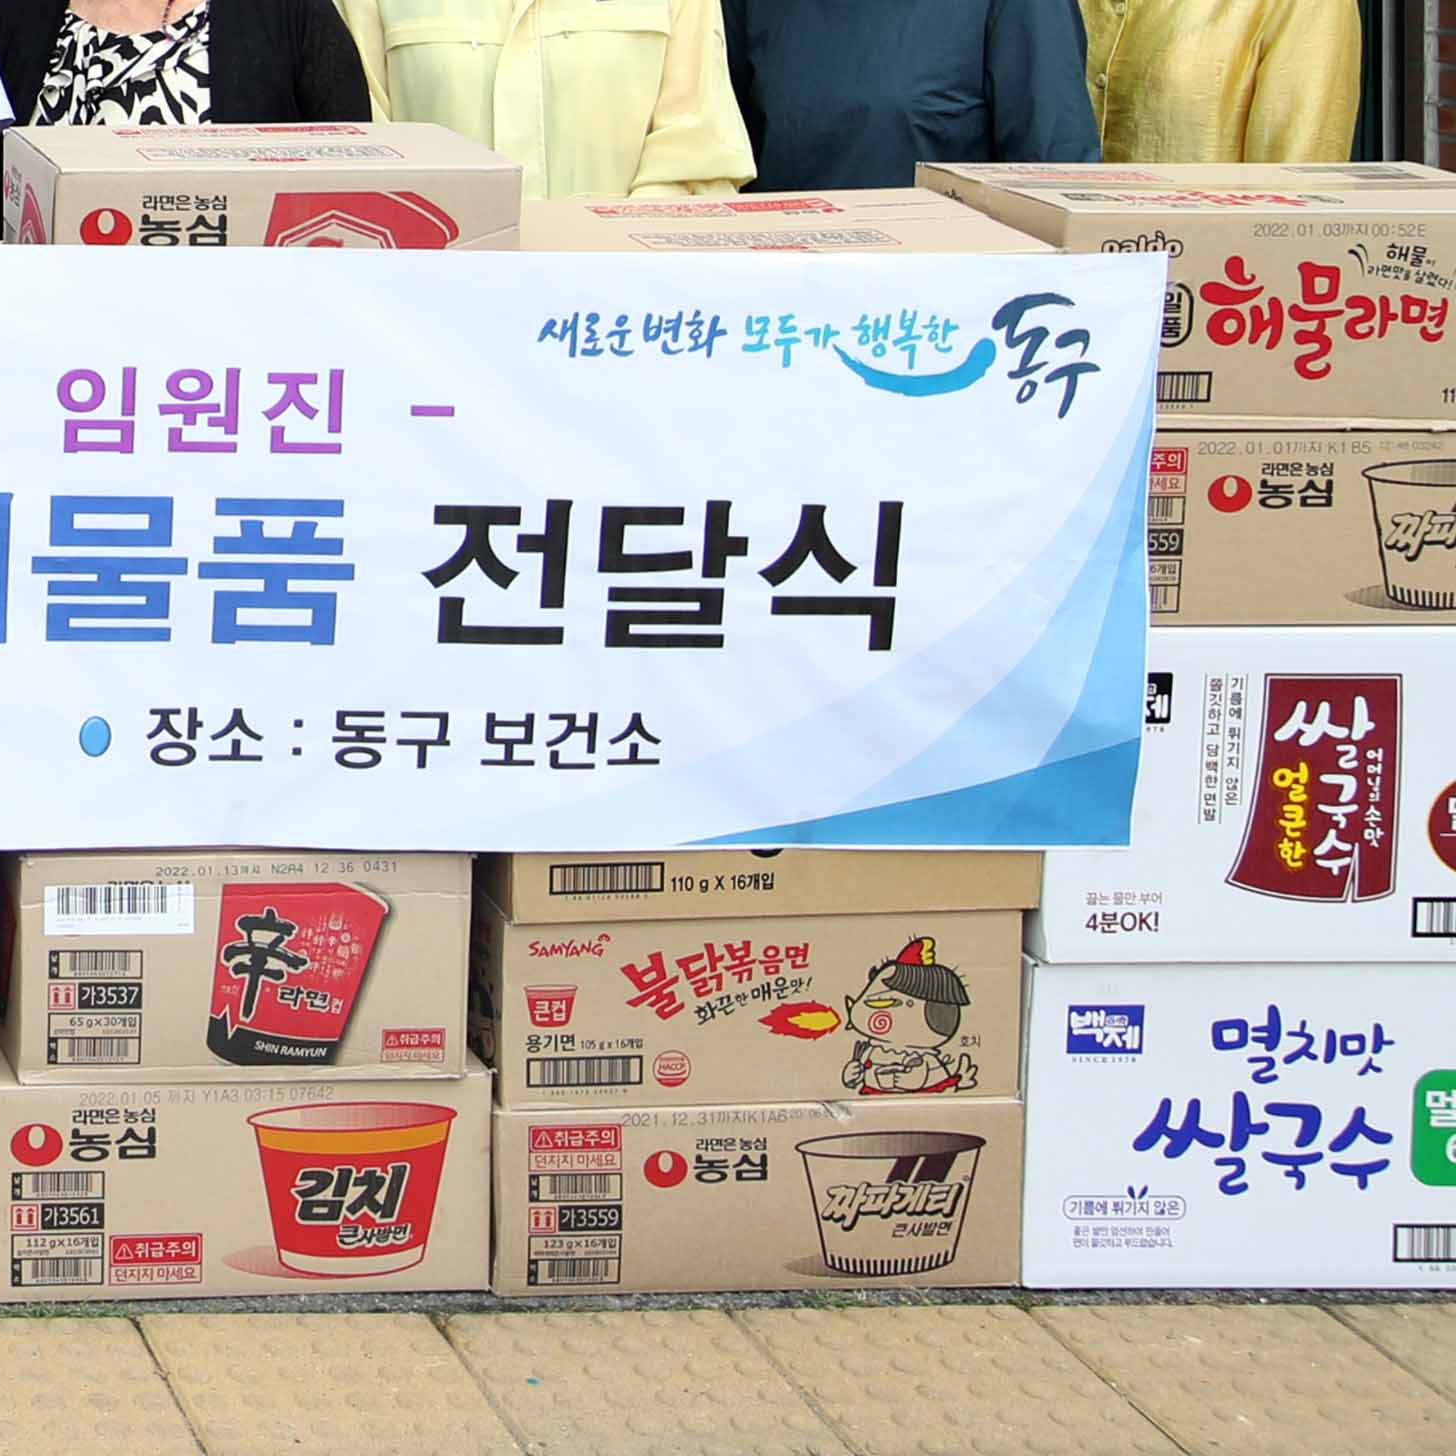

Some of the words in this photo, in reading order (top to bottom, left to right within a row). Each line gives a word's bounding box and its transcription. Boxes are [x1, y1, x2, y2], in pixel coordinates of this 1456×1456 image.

[142, 195, 189, 211] 라면은
[194, 195, 227, 210] 농심
[1200, 256, 1449, 380] 해물라면
[537, 310, 634, 357] 새로운
[643, 309, 727, 358] 변화
[741, 314, 839, 368] 모두가
[853, 309, 959, 369] 행복한
[991, 292, 1100, 419] 동구
[56, 362, 347, 458] 임원진
[1258, 479, 1333, 508] 농심
[423, 499, 904, 653] 전달식
[146, 706, 266, 765] 장소
[333, 708, 450, 769] 동구
[480, 708, 662, 769] 보건소
[1274, 697, 1375, 875] 쌀국수
[1273, 762, 1309, 869] 얼큰한
[671, 876, 694, 892] 110
[731, 872, 775, 892] 16개입
[1086, 912, 1160, 934] 4분OK!
[529, 940, 604, 958] SAMYANG
[220, 906, 310, 1022] 辛
[620, 941, 809, 1020] 불닭볶음면
[82, 986, 139, 1006] 가3537
[535, 999, 566, 1021] 큰컵
[694, 993, 749, 1025] 화끈한
[255, 1040, 279, 1054] SHIN
[281, 1044, 326, 1057] RAMYUN
[526, 1034, 575, 1053] 용기면
[1212, 1005, 1394, 1084] 멸치맛
[72, 1109, 120, 1124] 라면은
[69, 1127, 156, 1162] 농심
[554, 1129, 617, 1147] 취급주의
[696, 1138, 736, 1151] 라면은
[1133, 1091, 1392, 1195] 쌀국수
[534, 1154, 573, 1169] 던지지
[576, 1153, 617, 1168] 마세요
[694, 1153, 768, 1184] 농심
[293, 1162, 410, 1223] 김치
[44, 1208, 100, 1227] 가3561
[822, 1181, 964, 1231] 짜파게티
[1069, 1202, 1108, 1215] 기름에
[1112, 1201, 1149, 1215] 튀기지
[1154, 1202, 1180, 1215] 않은
[560, 1208, 619, 1228] 가3559
[336, 1224, 410, 1247] 큰사발면
[891, 1222, 951, 1238] 큰사발면
[135, 1242, 195, 1258] 취급주의
